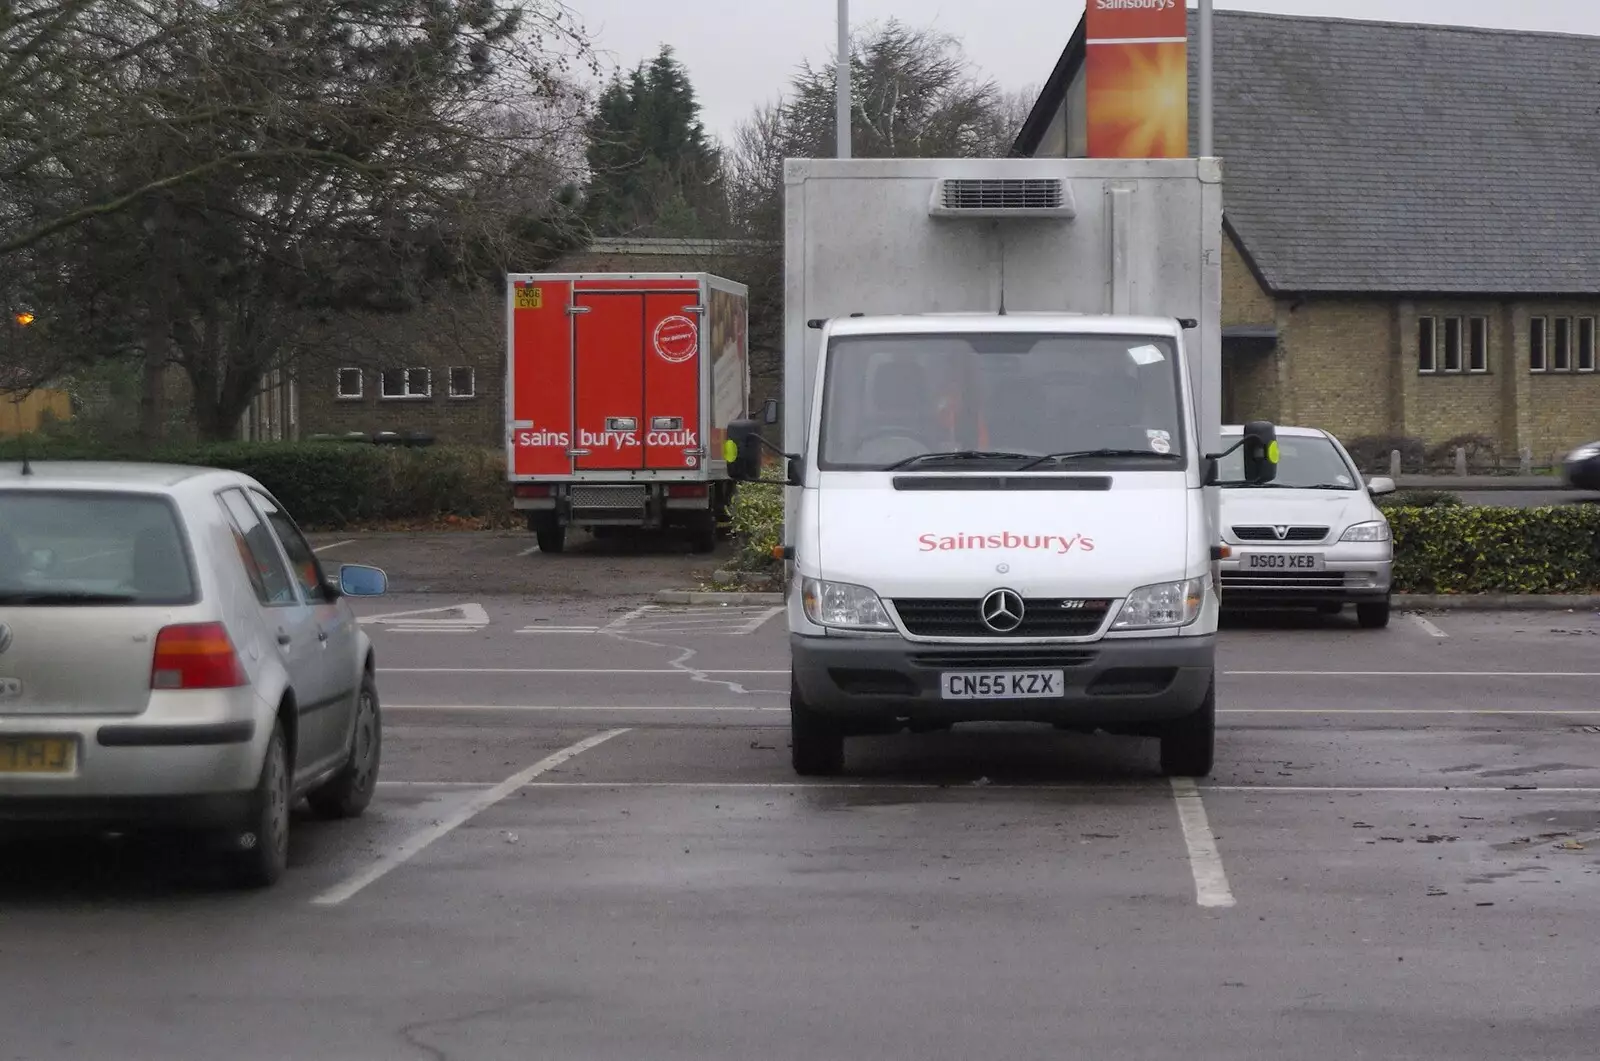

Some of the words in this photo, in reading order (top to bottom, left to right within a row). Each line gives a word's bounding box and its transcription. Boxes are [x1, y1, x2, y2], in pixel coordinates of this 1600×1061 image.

[1096, 0, 1176, 11] Sainsburys
[517, 289, 541, 298] CN06
[520, 298, 538, 307] CYU
[520, 429, 569, 446] sains
[580, 428, 641, 450] burys.
[646, 428, 697, 446] co.uk
[918, 531, 1095, 554] Sainsbury's
[1250, 555, 1285, 568] DS03
[1289, 555, 1315, 568] XEB
[949, 675, 1006, 695] CN55
[1011, 673, 1054, 695] KZX
